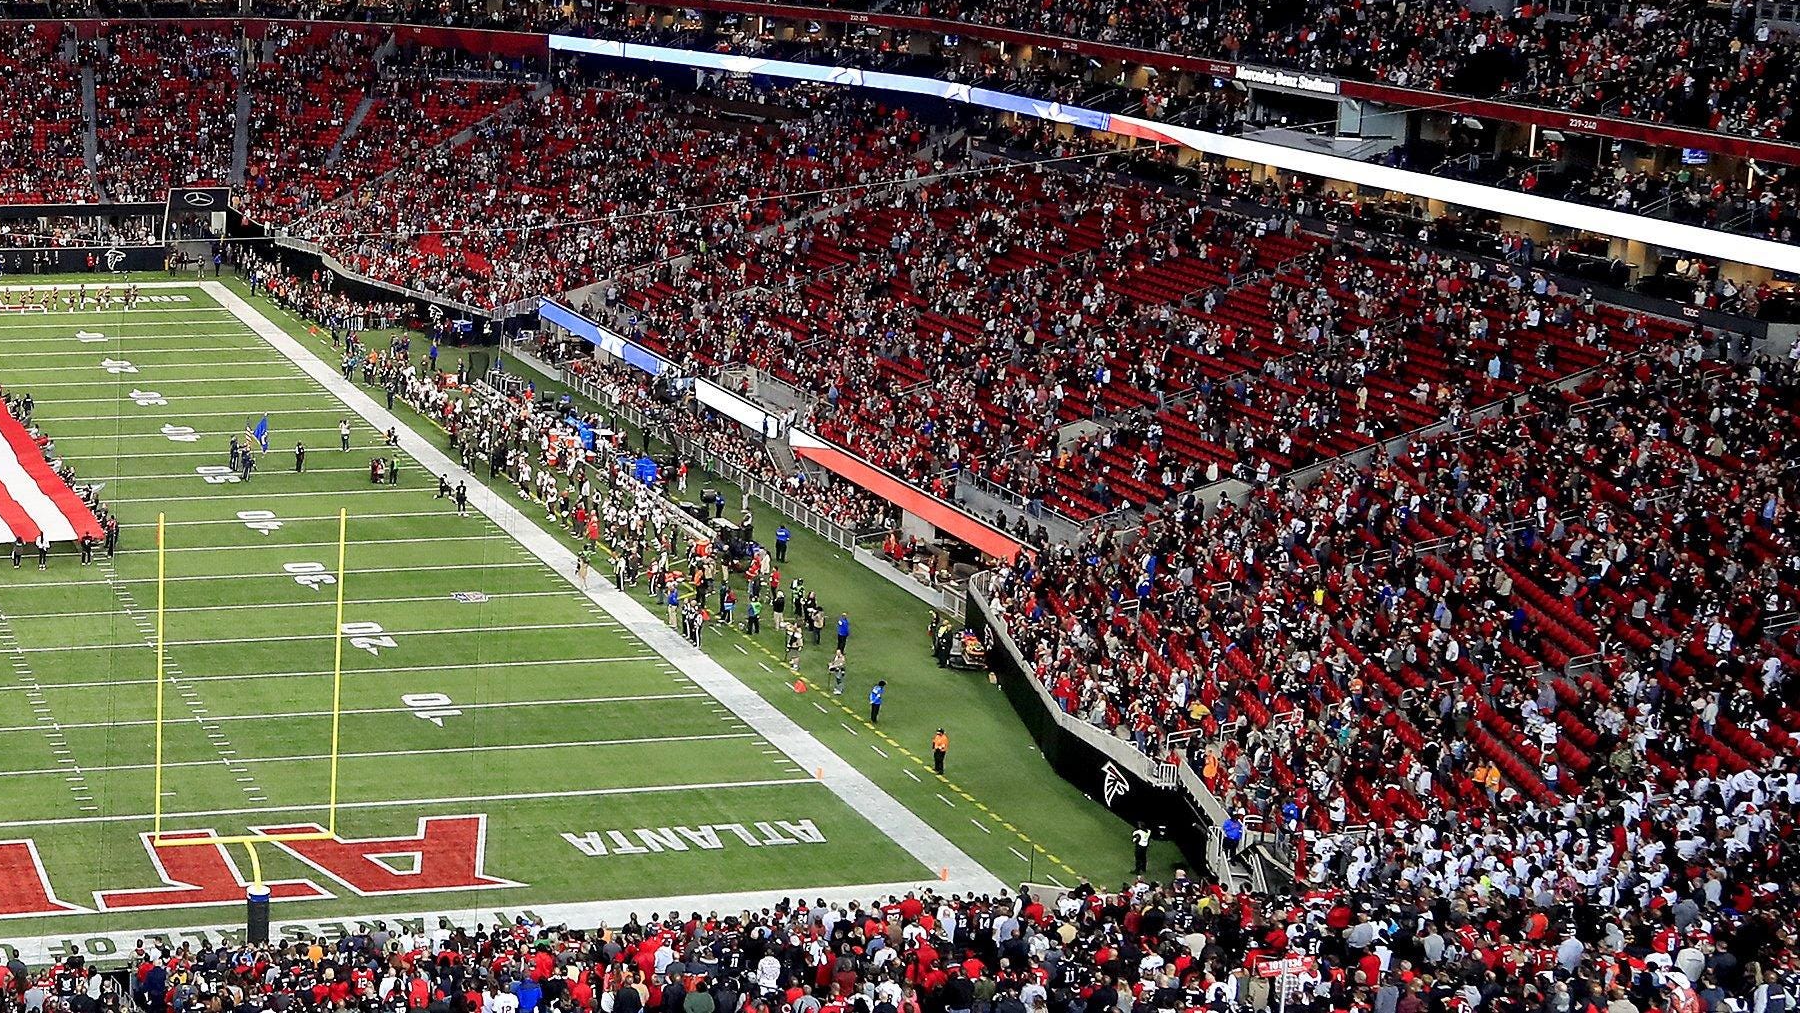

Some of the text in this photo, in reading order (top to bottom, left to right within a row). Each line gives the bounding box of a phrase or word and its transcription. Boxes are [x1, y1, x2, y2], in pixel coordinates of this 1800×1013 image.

[1235, 65, 1336, 94] Mercedes-Benz Stadium
[1569, 118, 1598, 130] 239-240
[196, 466, 242, 484] 50
[236, 510, 284, 531] 40
[283, 562, 338, 585] 30
[341, 622, 398, 649] 20
[401, 692, 463, 720] 10
[561, 818, 828, 857] ATLANTA
[979, 917, 991, 930] 14
[48, 937, 117, 959] OF
